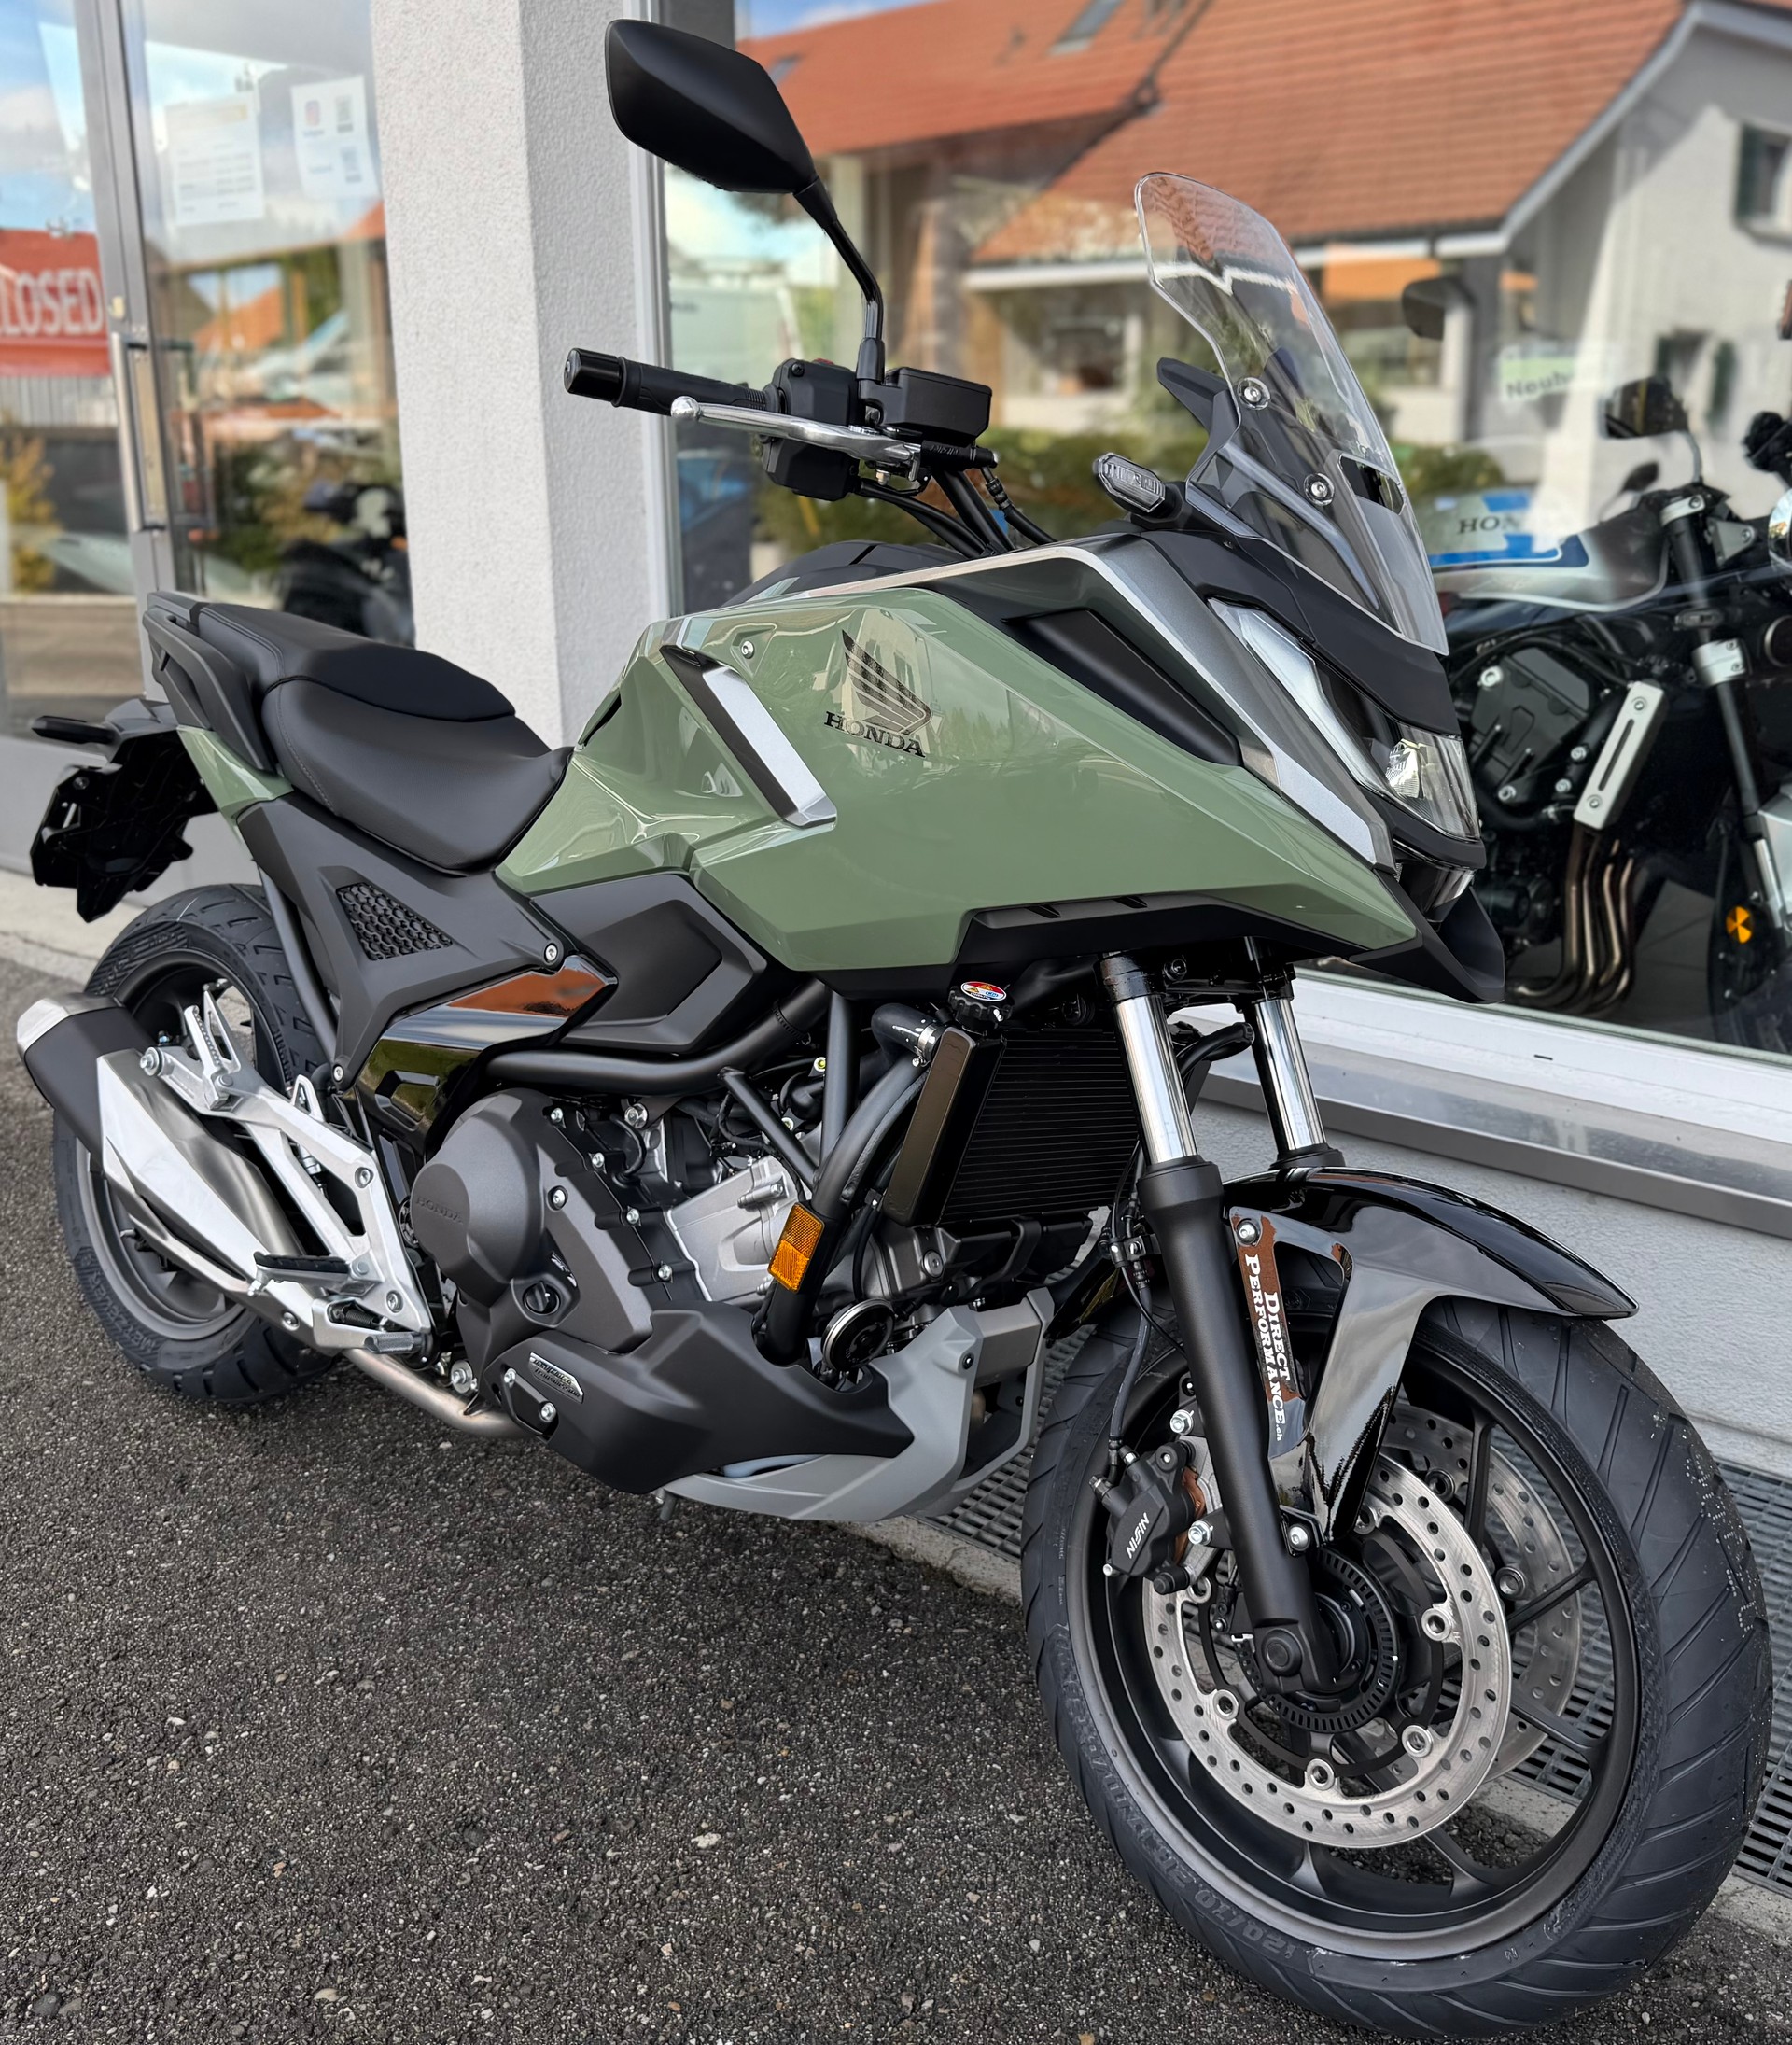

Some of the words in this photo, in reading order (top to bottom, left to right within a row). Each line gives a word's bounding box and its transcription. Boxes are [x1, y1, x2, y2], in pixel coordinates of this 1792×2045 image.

[0, 269, 104, 334] LOSED
[1458, 515, 1520, 535] HON
[824, 711, 926, 758] HONDA
[1264, 1291, 1291, 1381] DIRECT
